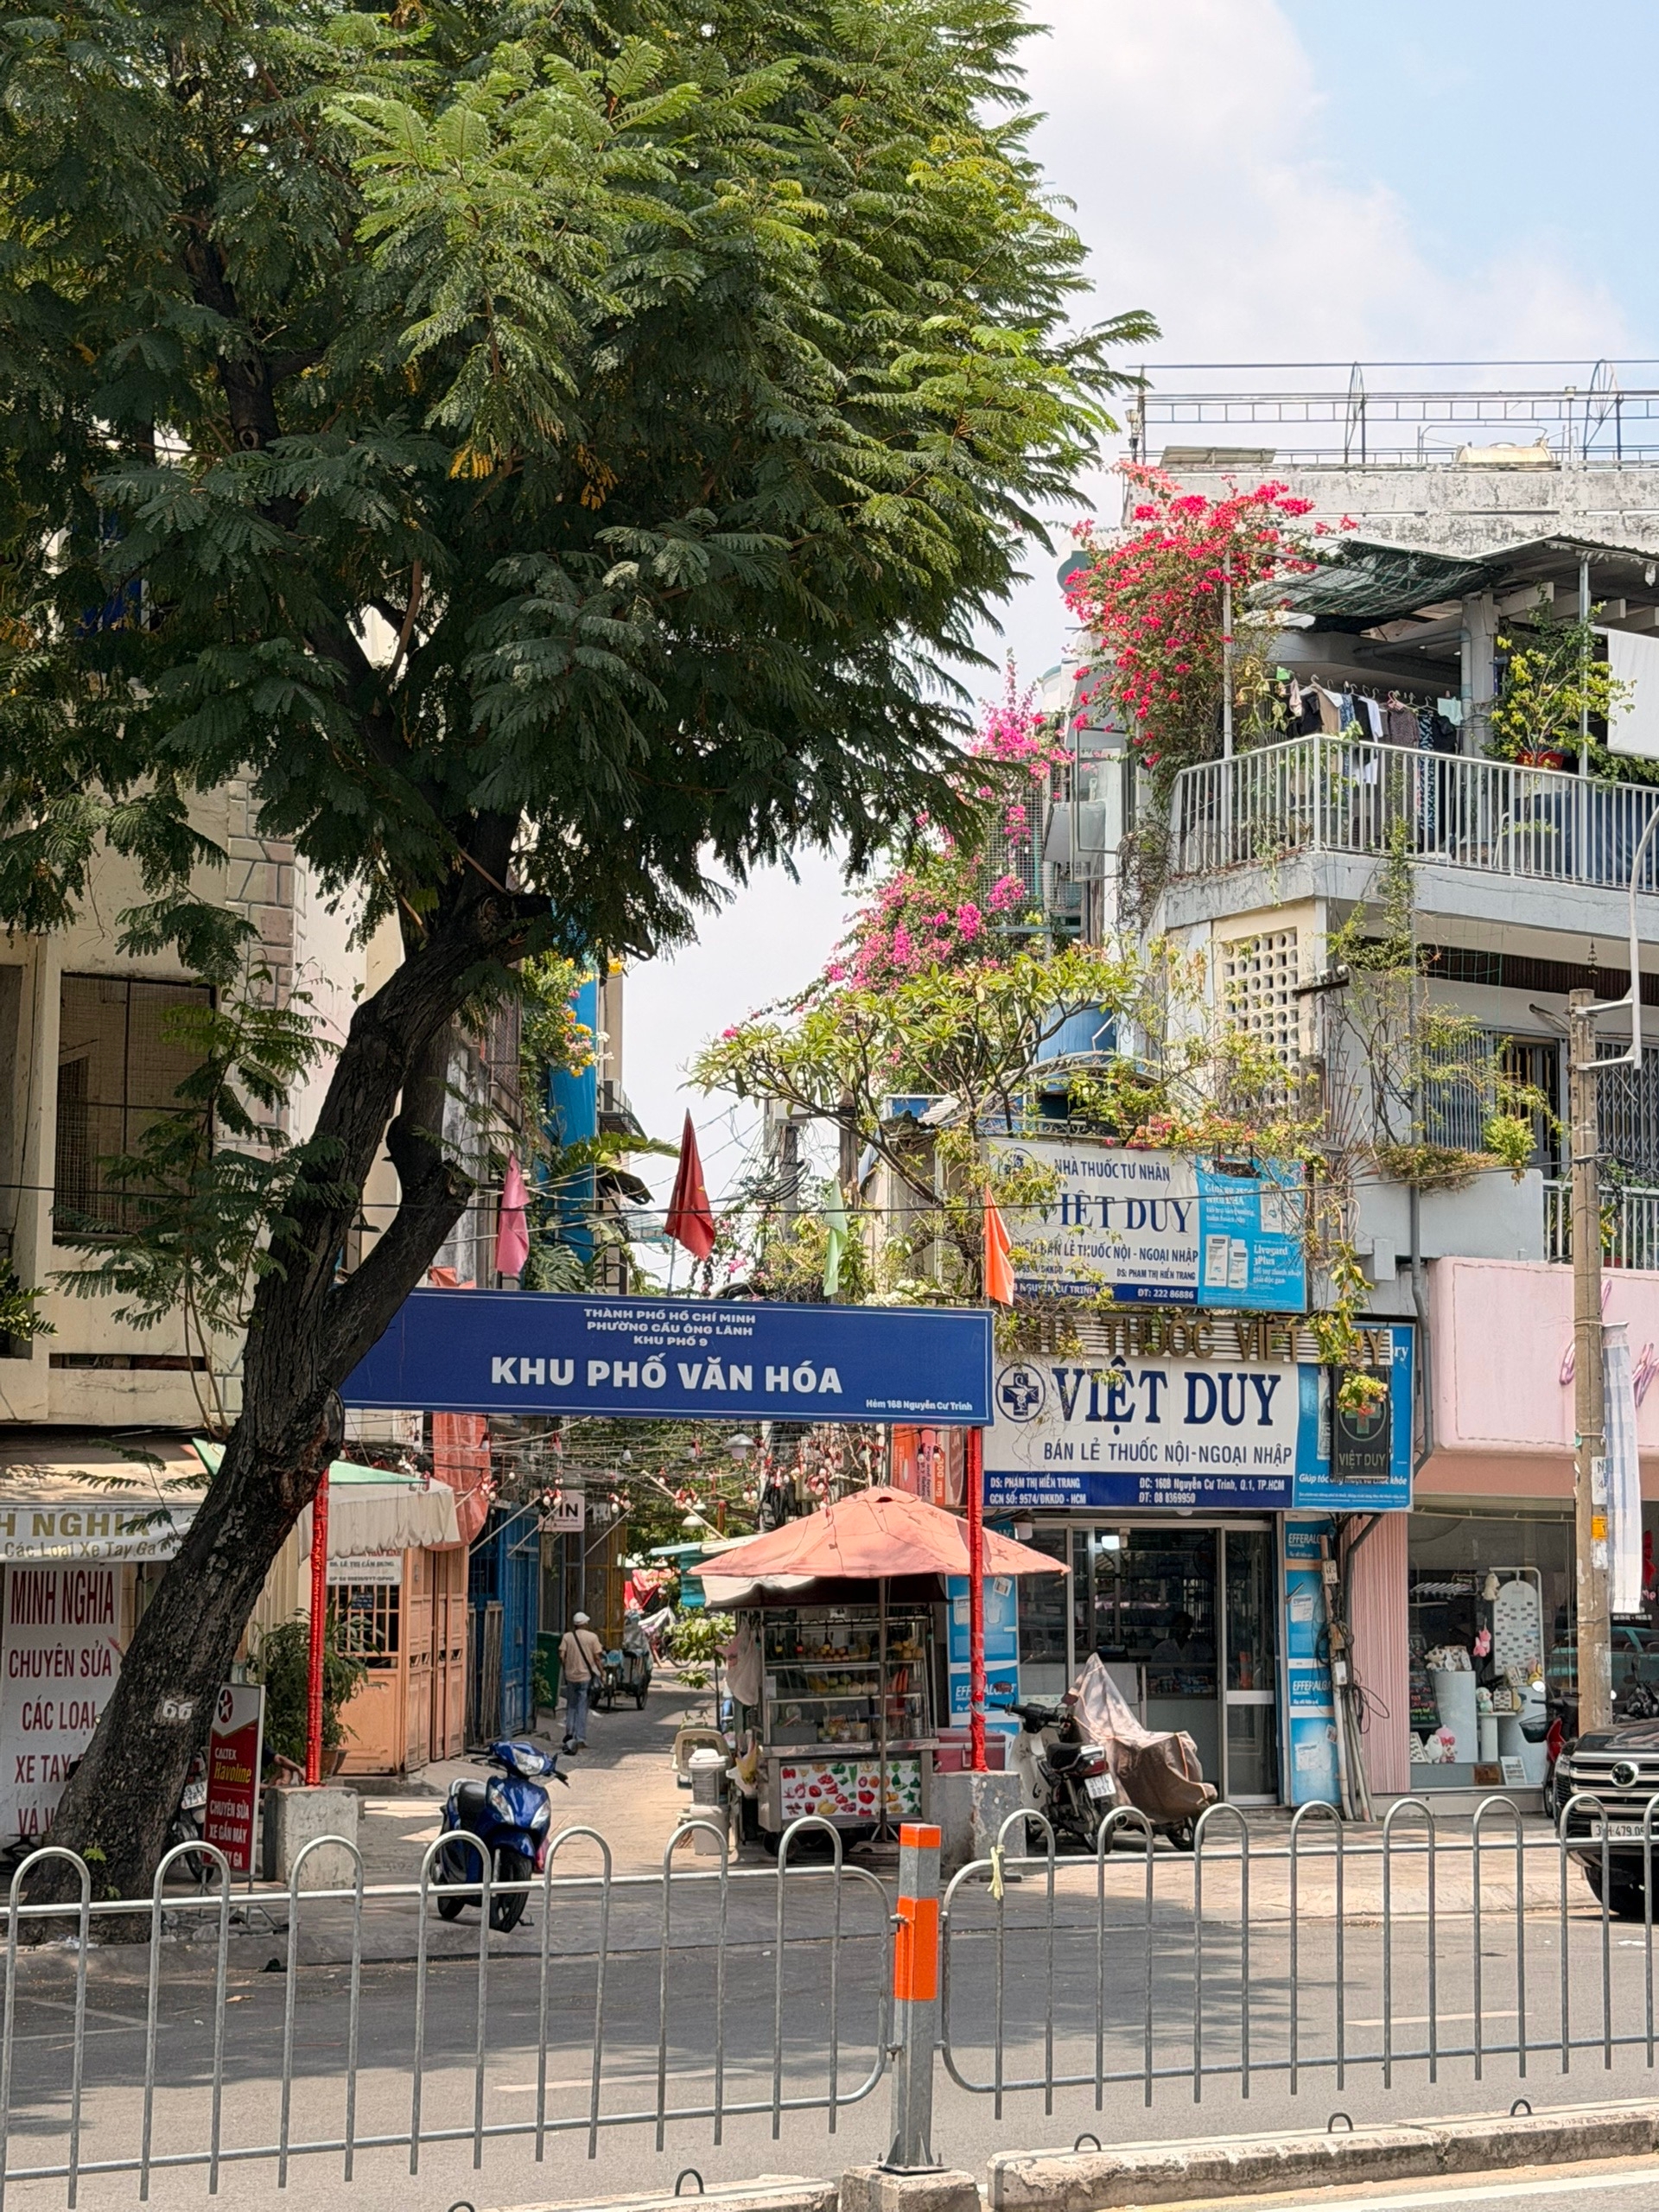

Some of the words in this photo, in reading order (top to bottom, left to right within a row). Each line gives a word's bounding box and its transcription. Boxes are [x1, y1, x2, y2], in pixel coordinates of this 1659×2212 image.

[1054, 1155, 1078, 1177] NHÀ
[1080, 1157, 1119, 1179] THUỐC
[1121, 1161, 1138, 1179] TƯ
[1139, 1161, 1171, 1182] NHÂN
[1125, 1196, 1192, 1234] DUY
[1065, 1240, 1077, 1256] LẺ
[1077, 1242, 1112, 1260] THUỐC
[1114, 1243, 1131, 1261] NỘI
[1140, 1247, 1169, 1265] NGOẠI
[1172, 1246, 1199, 1268] NHẬP
[1176, 1271, 1196, 1281] TRANG
[1069, 1285, 1096, 1294] TRINH
[1153, 1288, 1168, 1298] 222
[584, 1308, 633, 1319] THÀNH
[636, 1310, 666, 1320] PHỐ
[692, 1312, 717, 1322] CHÍ
[719, 1314, 756, 1324] MINH
[587, 1321, 649, 1332] PHƯỜNG
[683, 1323, 713, 1335] ÔNG
[715, 1324, 753, 1336] LÃNH
[633, 1335, 664, 1344] KHU
[667, 1336, 696, 1346] PHỐ
[699, 1338, 709, 1347] 9
[491, 1357, 575, 1387] KHU
[588, 1352, 667, 1389] PHỐ
[677, 1357, 753, 1391] VĂN
[765, 1360, 844, 1394] HÓA
[1052, 1355, 1168, 1435] VIỆT
[1184, 1371, 1281, 1427] DUY
[903, 1399, 937, 1411] Nguyễn
[1044, 1439, 1074, 1460] BÁN
[1081, 1437, 1101, 1461] LẺ
[1109, 1437, 1158, 1462] THUỐC
[1254, 1443, 1293, 1467] NHẬP
[1338, 1449, 1363, 1470] VIỆT
[1363, 1453, 1387, 1466] DUY
[1057, 1478, 1081, 1489] TRANG
[1173, 1476, 1202, 1491] Nguyễn
[1257, 1479, 1285, 1491] TP.HCM
[1299, 1473, 1317, 1485] Giúp
[1318, 1473, 1329, 1484] tóc
[1071, 1493, 1087, 1504] HCM
[559, 1503, 578, 1517] IN
[5, 1541, 35, 1557] Các
[79, 1542, 100, 1556] Xe
[105, 1541, 133, 1560] Tay
[136, 1541, 156, 1556] Ga
[11, 1571, 57, 1624] MINH
[10, 1643, 75, 1678] CHUYÊN
[80, 1640, 112, 1678] SỬA
[22, 1694, 54, 1731] CÁC
[162, 1700, 194, 1719] 66
[214, 1747, 237, 1760] CALTEX
[15, 1755, 36, 1783] XE
[214, 1762, 252, 1784] Havoline
[18, 1800, 39, 1836] VÁ
[209, 1823, 219, 1840] XE
